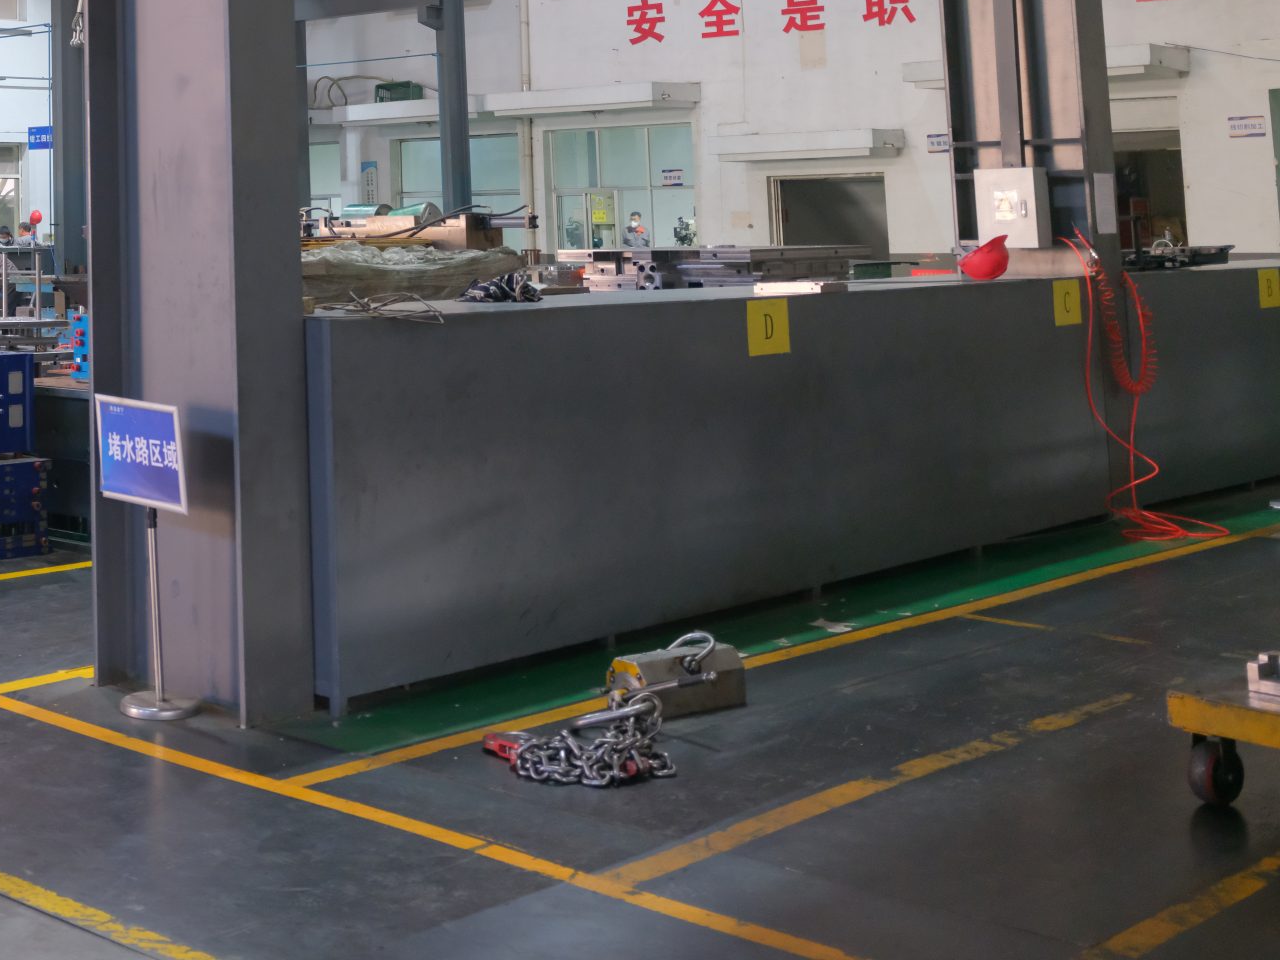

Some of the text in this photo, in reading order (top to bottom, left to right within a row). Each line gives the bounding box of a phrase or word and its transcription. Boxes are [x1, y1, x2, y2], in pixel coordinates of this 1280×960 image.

[1265, 278, 1273, 298] B
[1063, 291, 1071, 314] C
[763, 313, 774, 340] D
[107, 431, 179, 472] 堵水路区域
